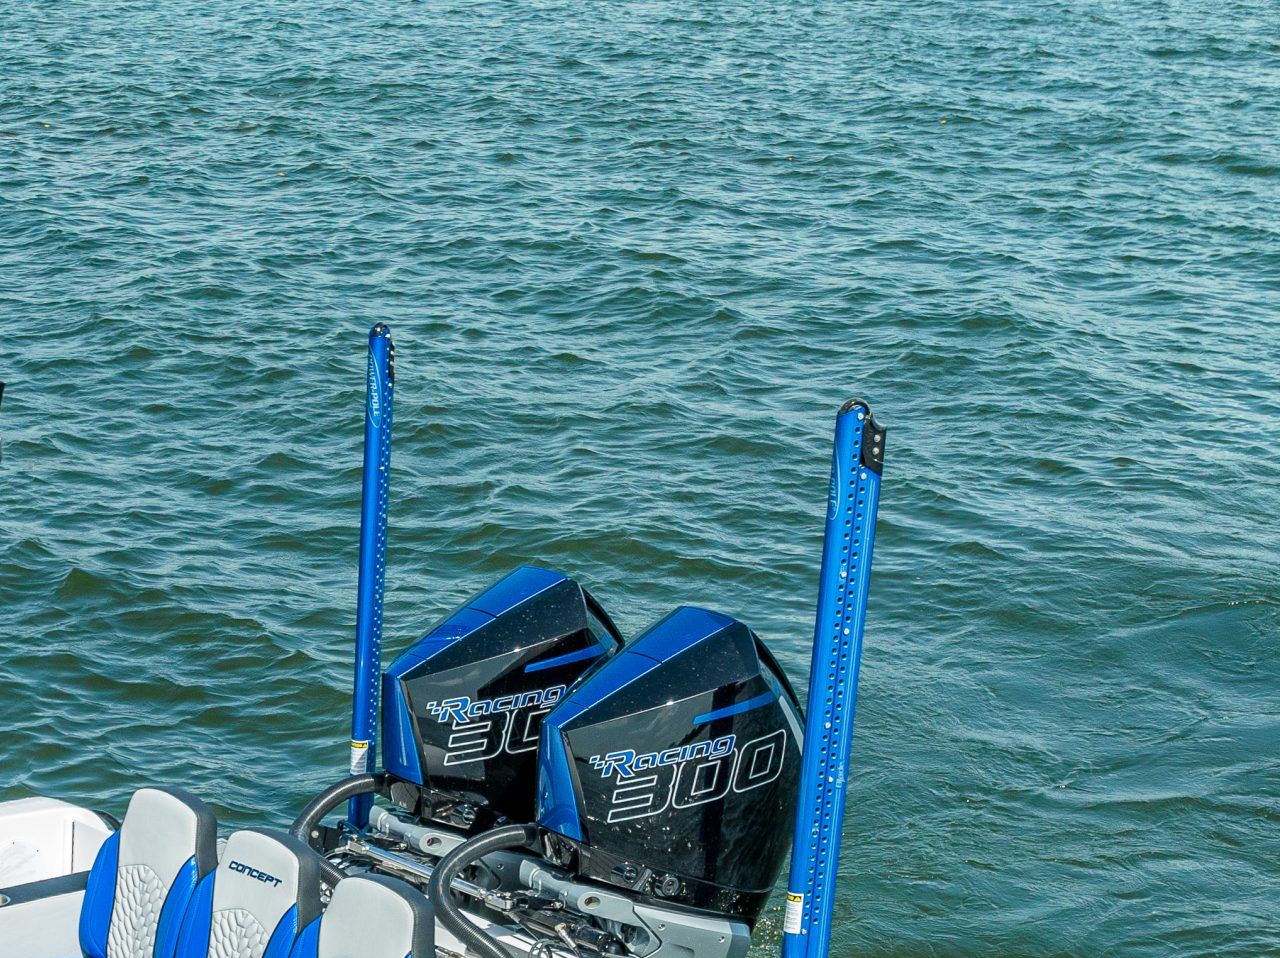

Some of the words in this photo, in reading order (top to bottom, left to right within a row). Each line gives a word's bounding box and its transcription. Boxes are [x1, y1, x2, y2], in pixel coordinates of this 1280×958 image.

[435, 684, 566, 724] Racing
[443, 708, 552, 766] 30
[598, 734, 736, 778] Racing
[607, 729, 787, 824] 300
[228, 860, 283, 888] CONCEPT
